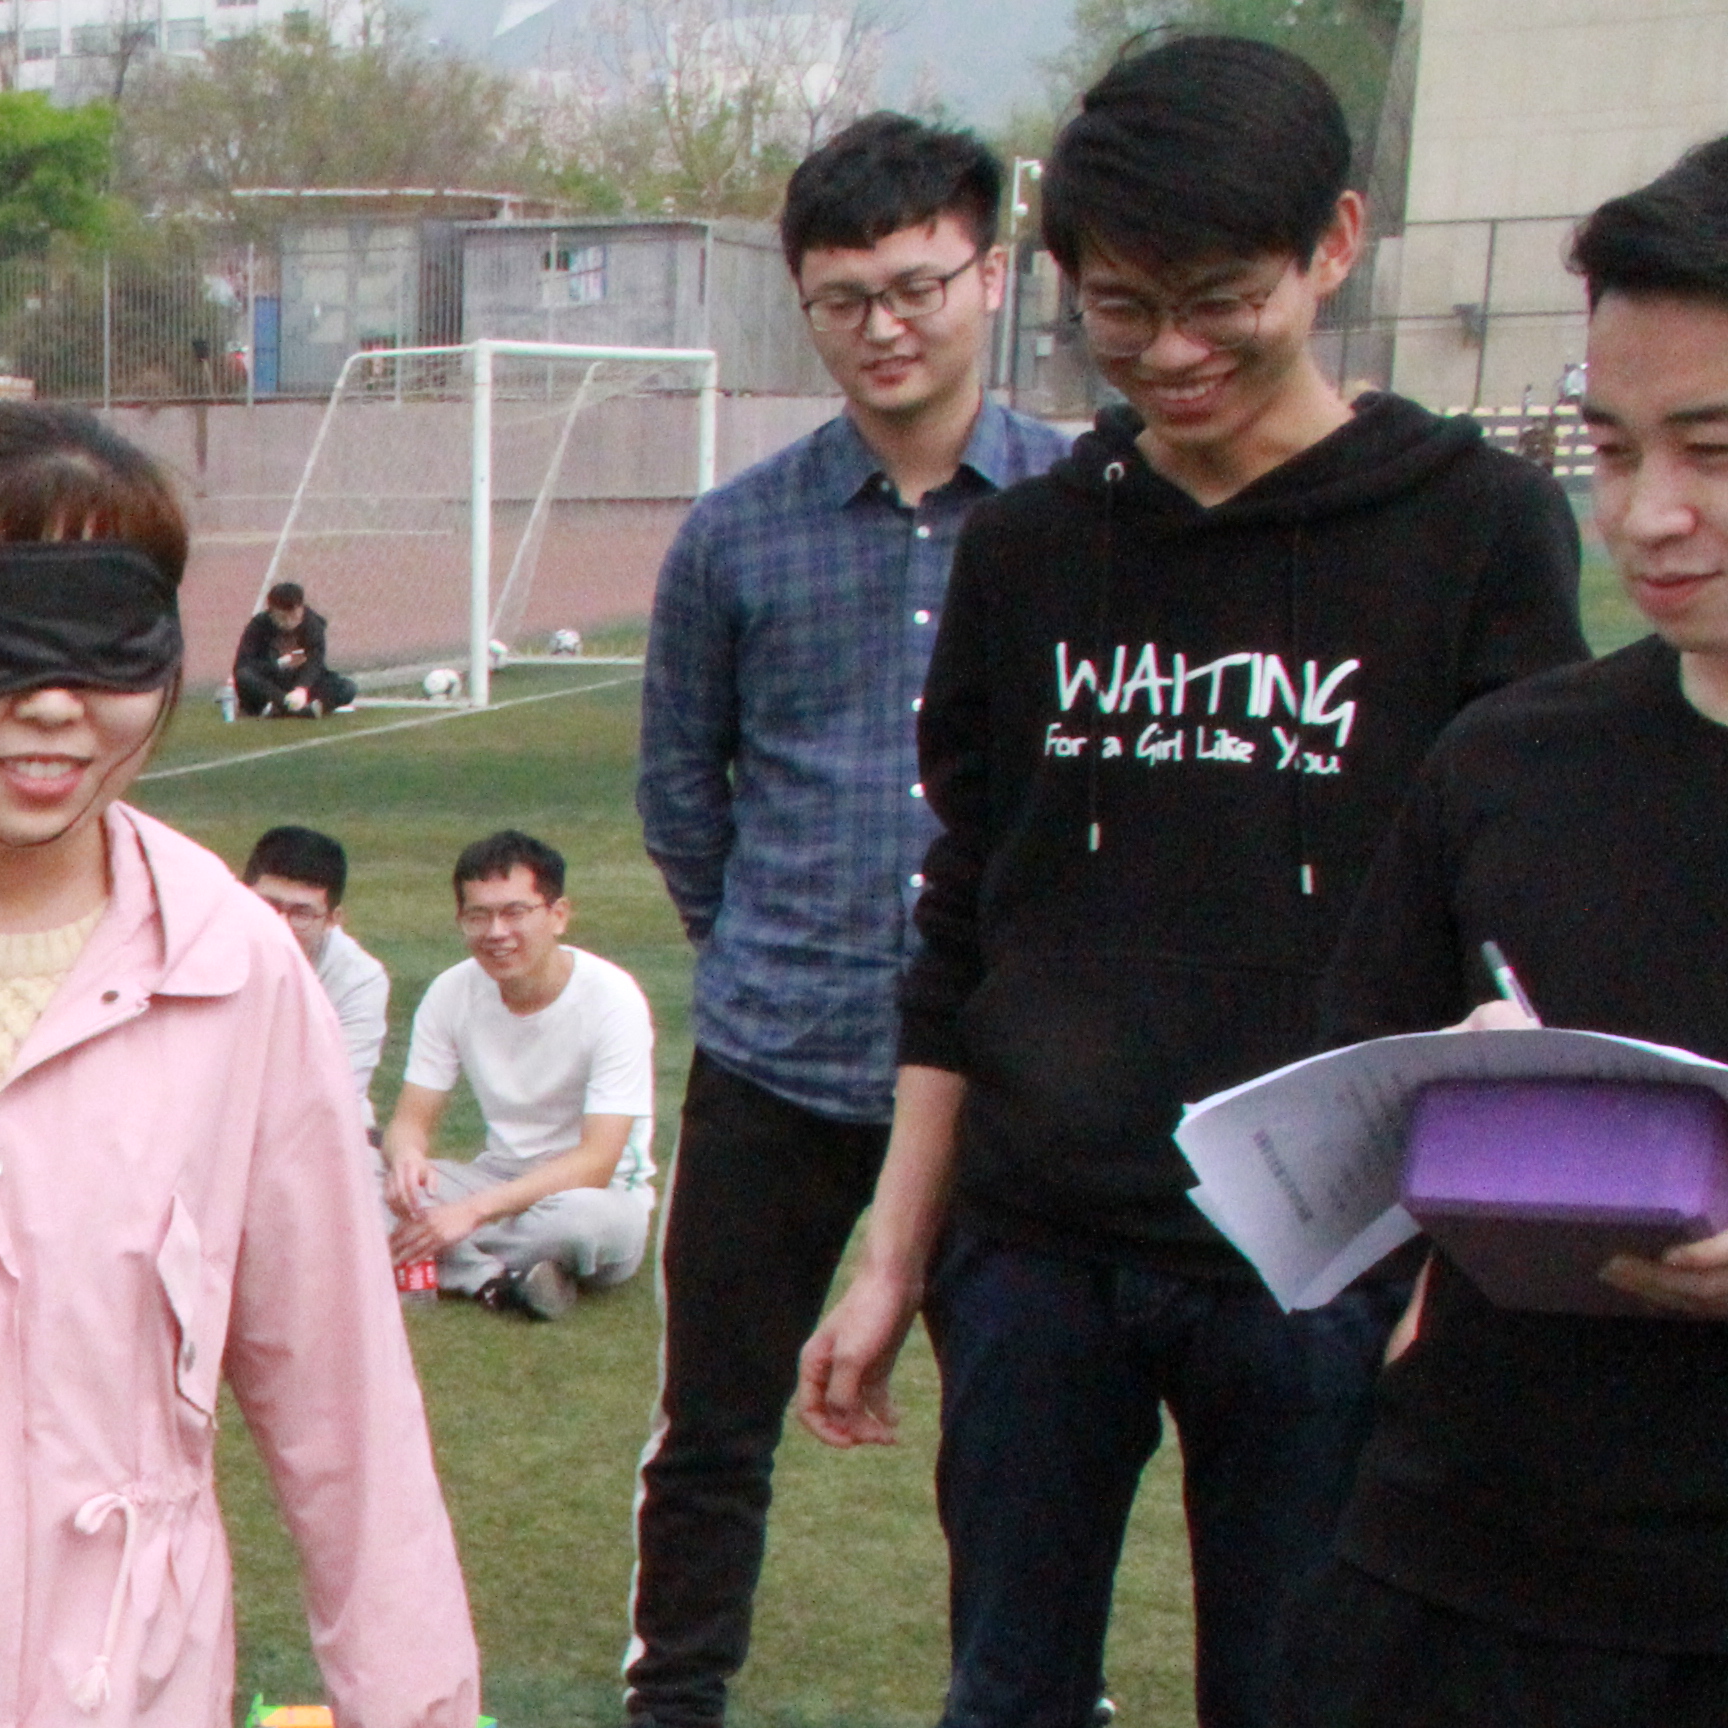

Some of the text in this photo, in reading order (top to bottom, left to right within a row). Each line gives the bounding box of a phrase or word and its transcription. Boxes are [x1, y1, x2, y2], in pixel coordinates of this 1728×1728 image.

[1055, 642, 1360, 748] WAITING
[1044, 722, 1088, 757] For
[1101, 736, 1122, 759] a
[1135, 723, 1184, 767] Girl
[1196, 725, 1257, 763] Like
